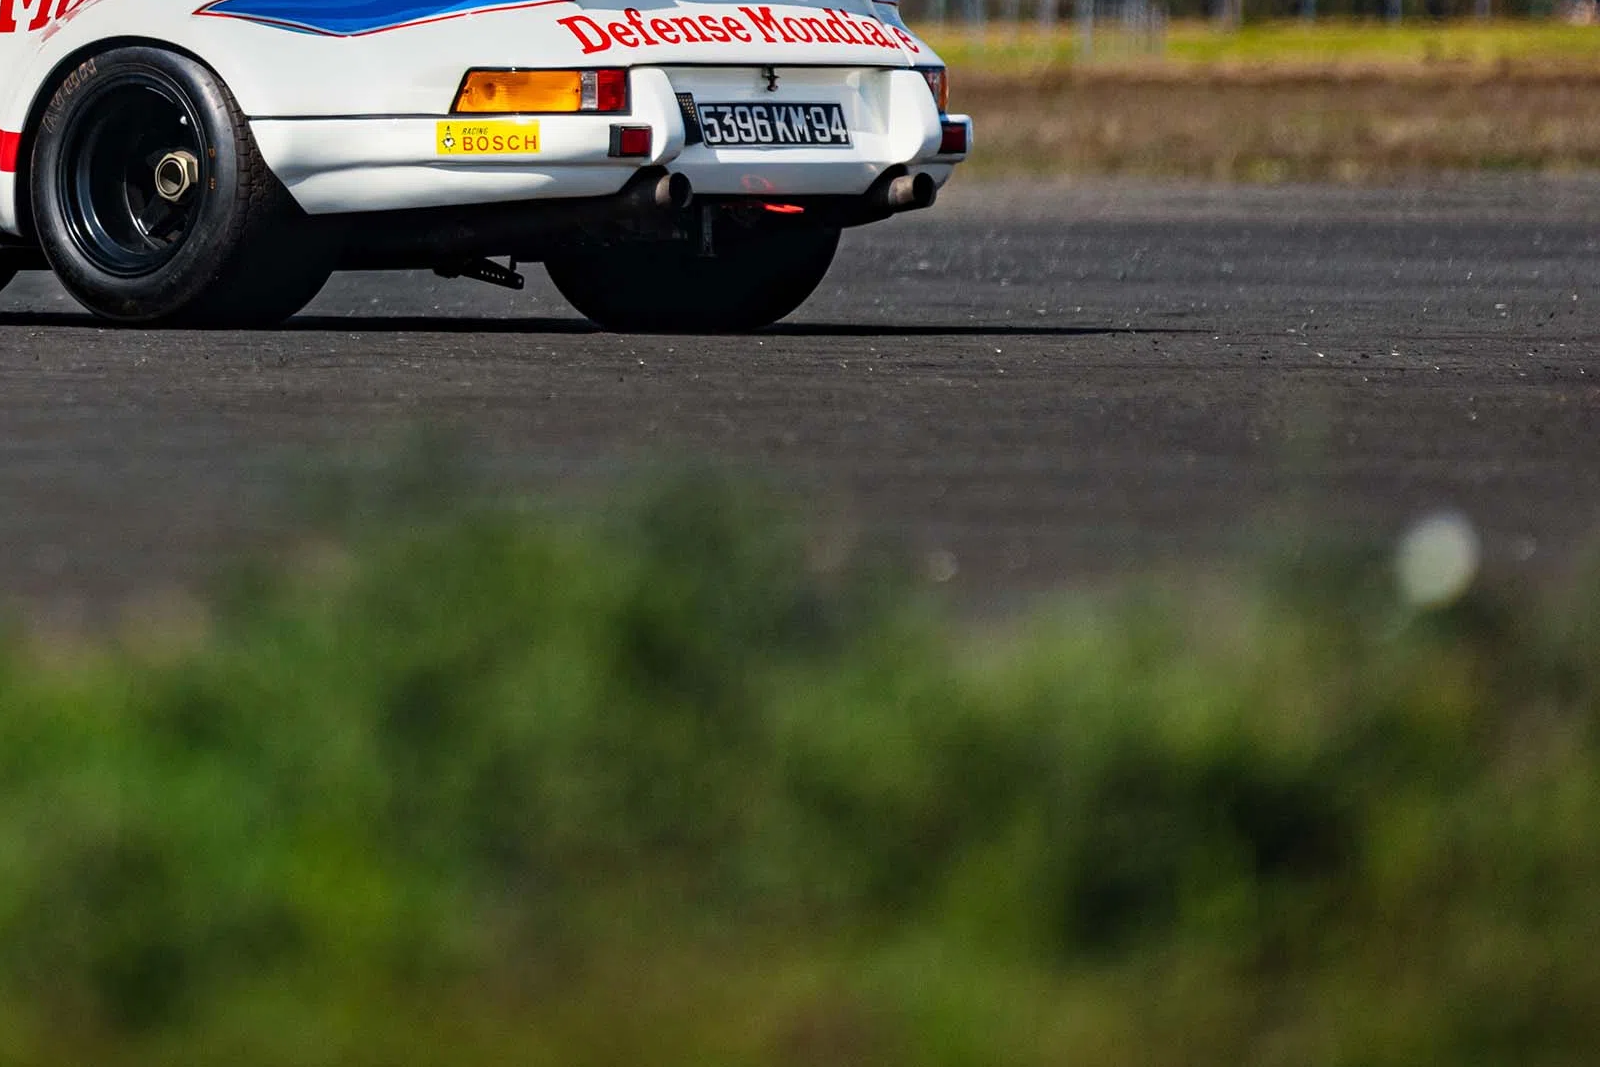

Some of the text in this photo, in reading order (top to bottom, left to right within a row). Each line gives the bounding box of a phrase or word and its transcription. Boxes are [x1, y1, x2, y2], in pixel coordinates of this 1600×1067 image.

[557, 7, 752, 54] Defense
[461, 127, 489, 135] RACING
[700, 105, 848, 143] 5396 KM 94
[462, 134, 537, 151] BOSCH
